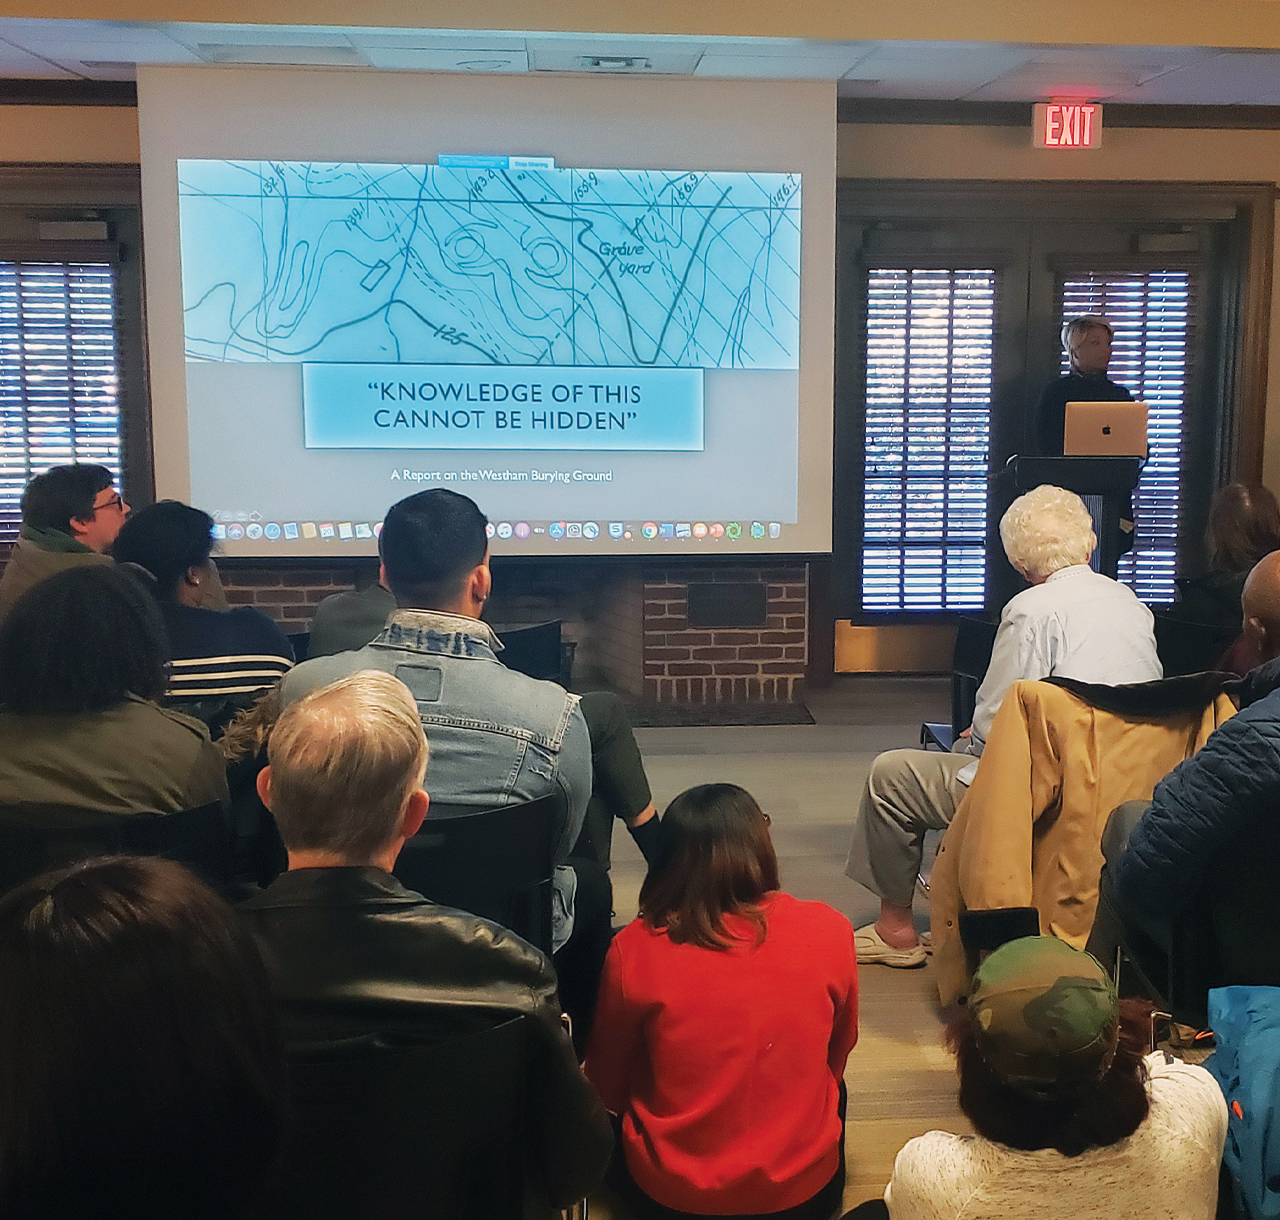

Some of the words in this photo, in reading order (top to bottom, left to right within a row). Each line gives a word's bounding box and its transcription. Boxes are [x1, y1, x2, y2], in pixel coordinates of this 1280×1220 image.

[1045, 105, 1095, 146] EXIT
[619, 260, 655, 278] yard
[367, 382, 543, 403] “KNOWLEDGE
[551, 384, 584, 403] OF
[588, 384, 642, 404] THIS
[373, 409, 486, 429] CANNOT
[495, 410, 522, 429] BE
[531, 410, 638, 430] HIDDEN”
[390, 469, 401, 480] A
[403, 469, 441, 483] Report
[444, 471, 458, 480] on
[461, 469, 478, 480] the
[478, 469, 528, 481] Westham
[531, 470, 571, 484] Burying
[572, 470, 613, 481] Ground
